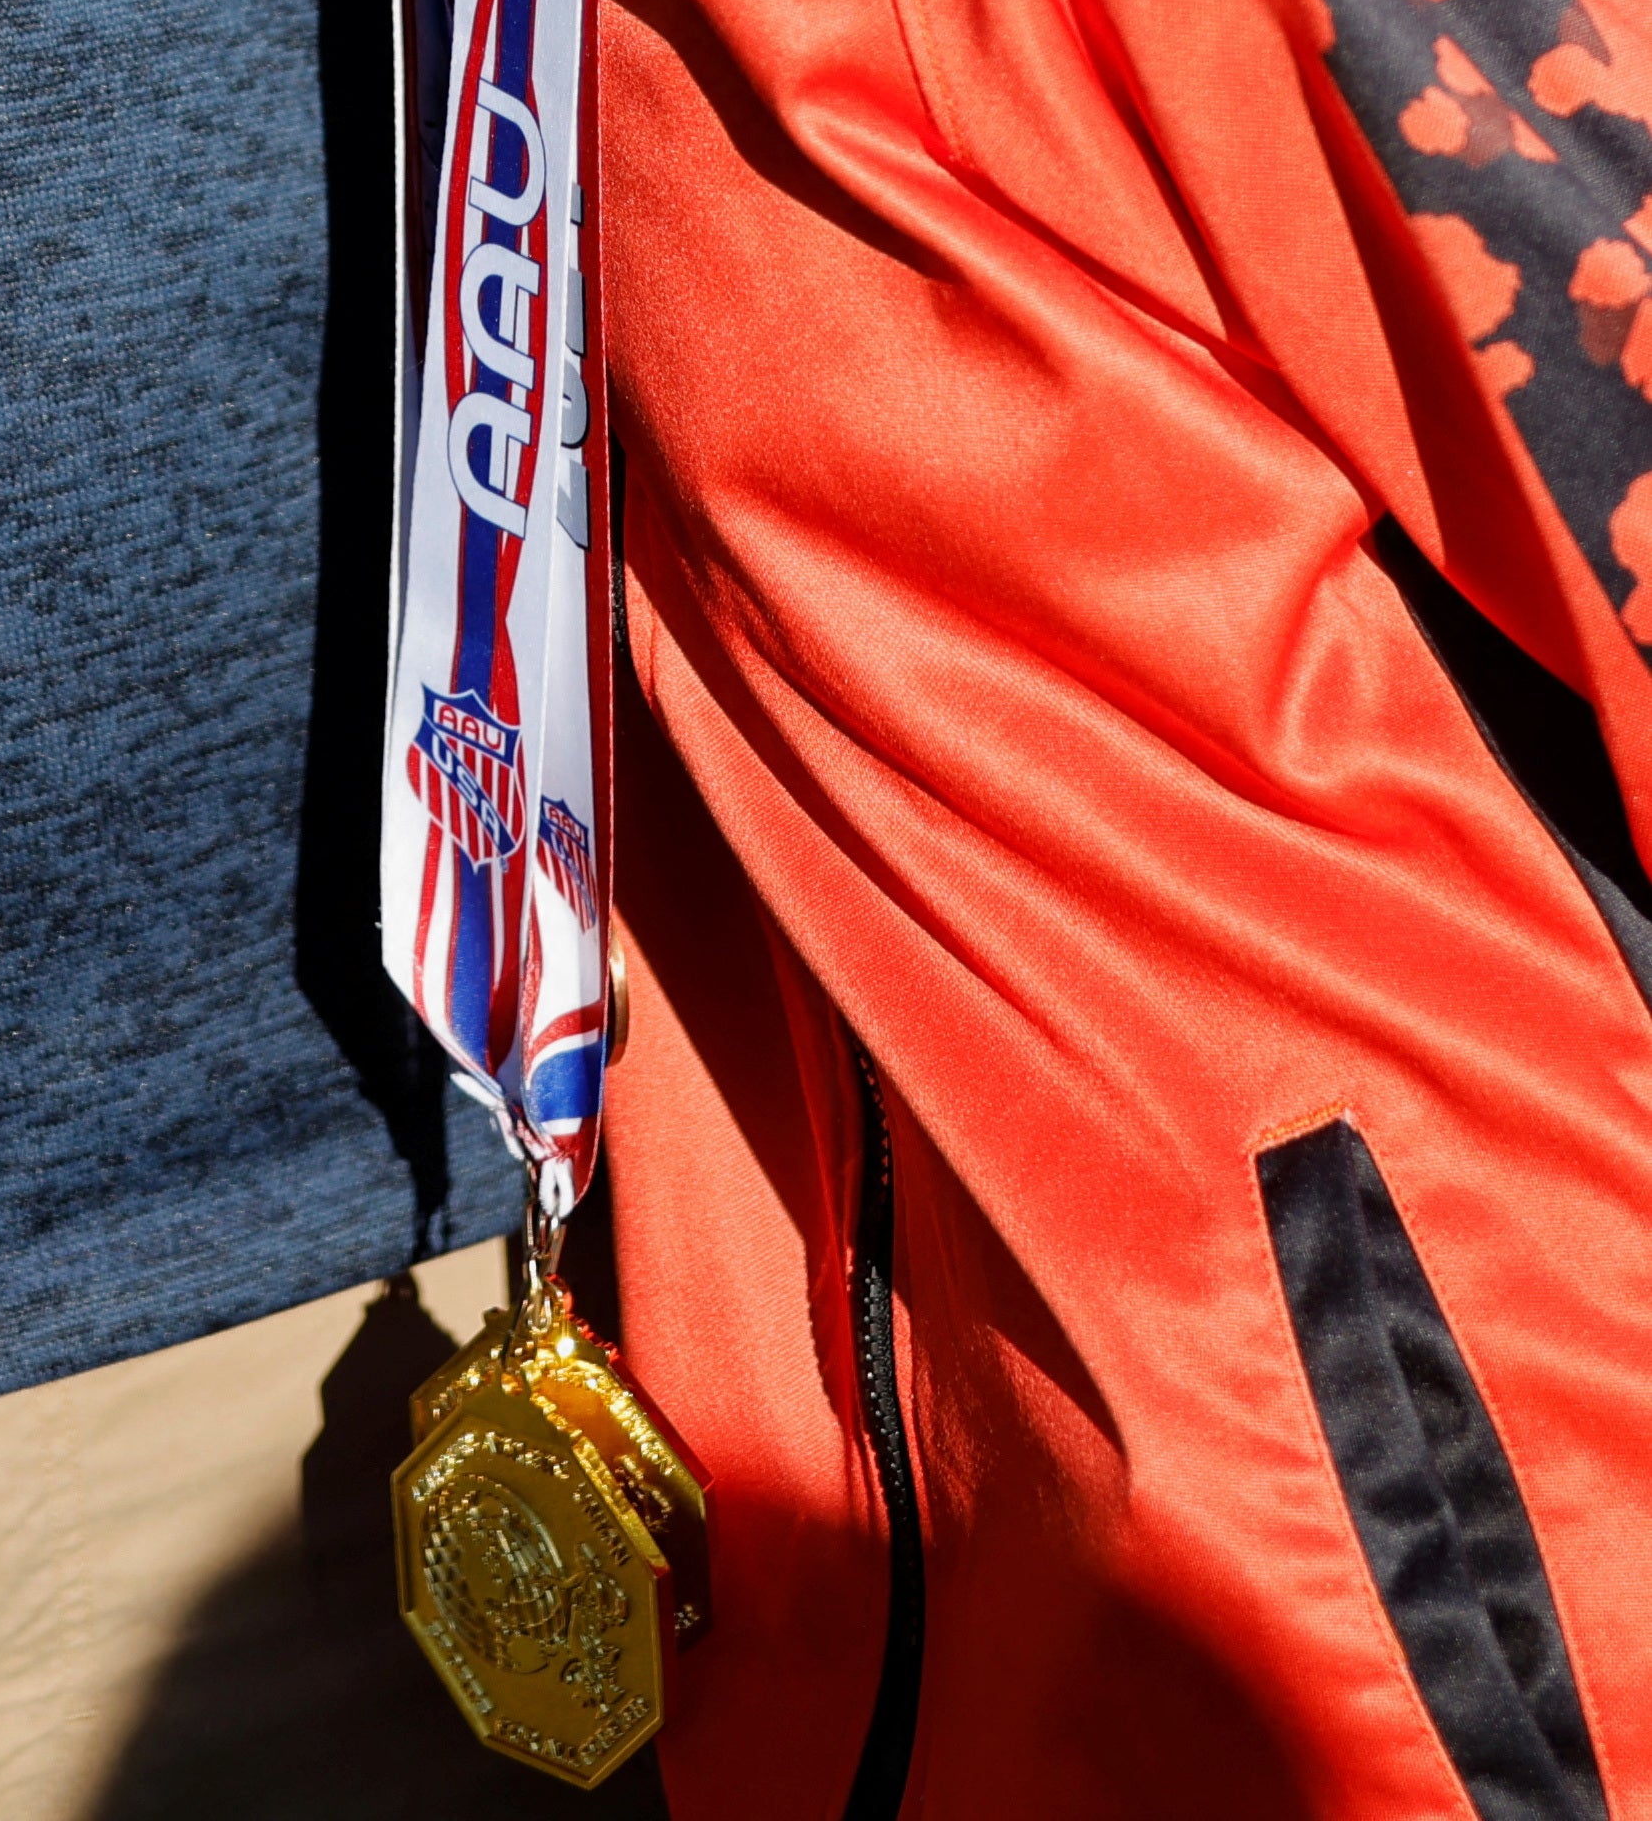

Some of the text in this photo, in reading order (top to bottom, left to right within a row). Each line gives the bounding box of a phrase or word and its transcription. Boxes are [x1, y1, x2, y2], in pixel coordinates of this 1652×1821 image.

[447, 77, 546, 540] AAU
[438, 703, 502, 751] AAU
[431, 732, 501, 854] USA
